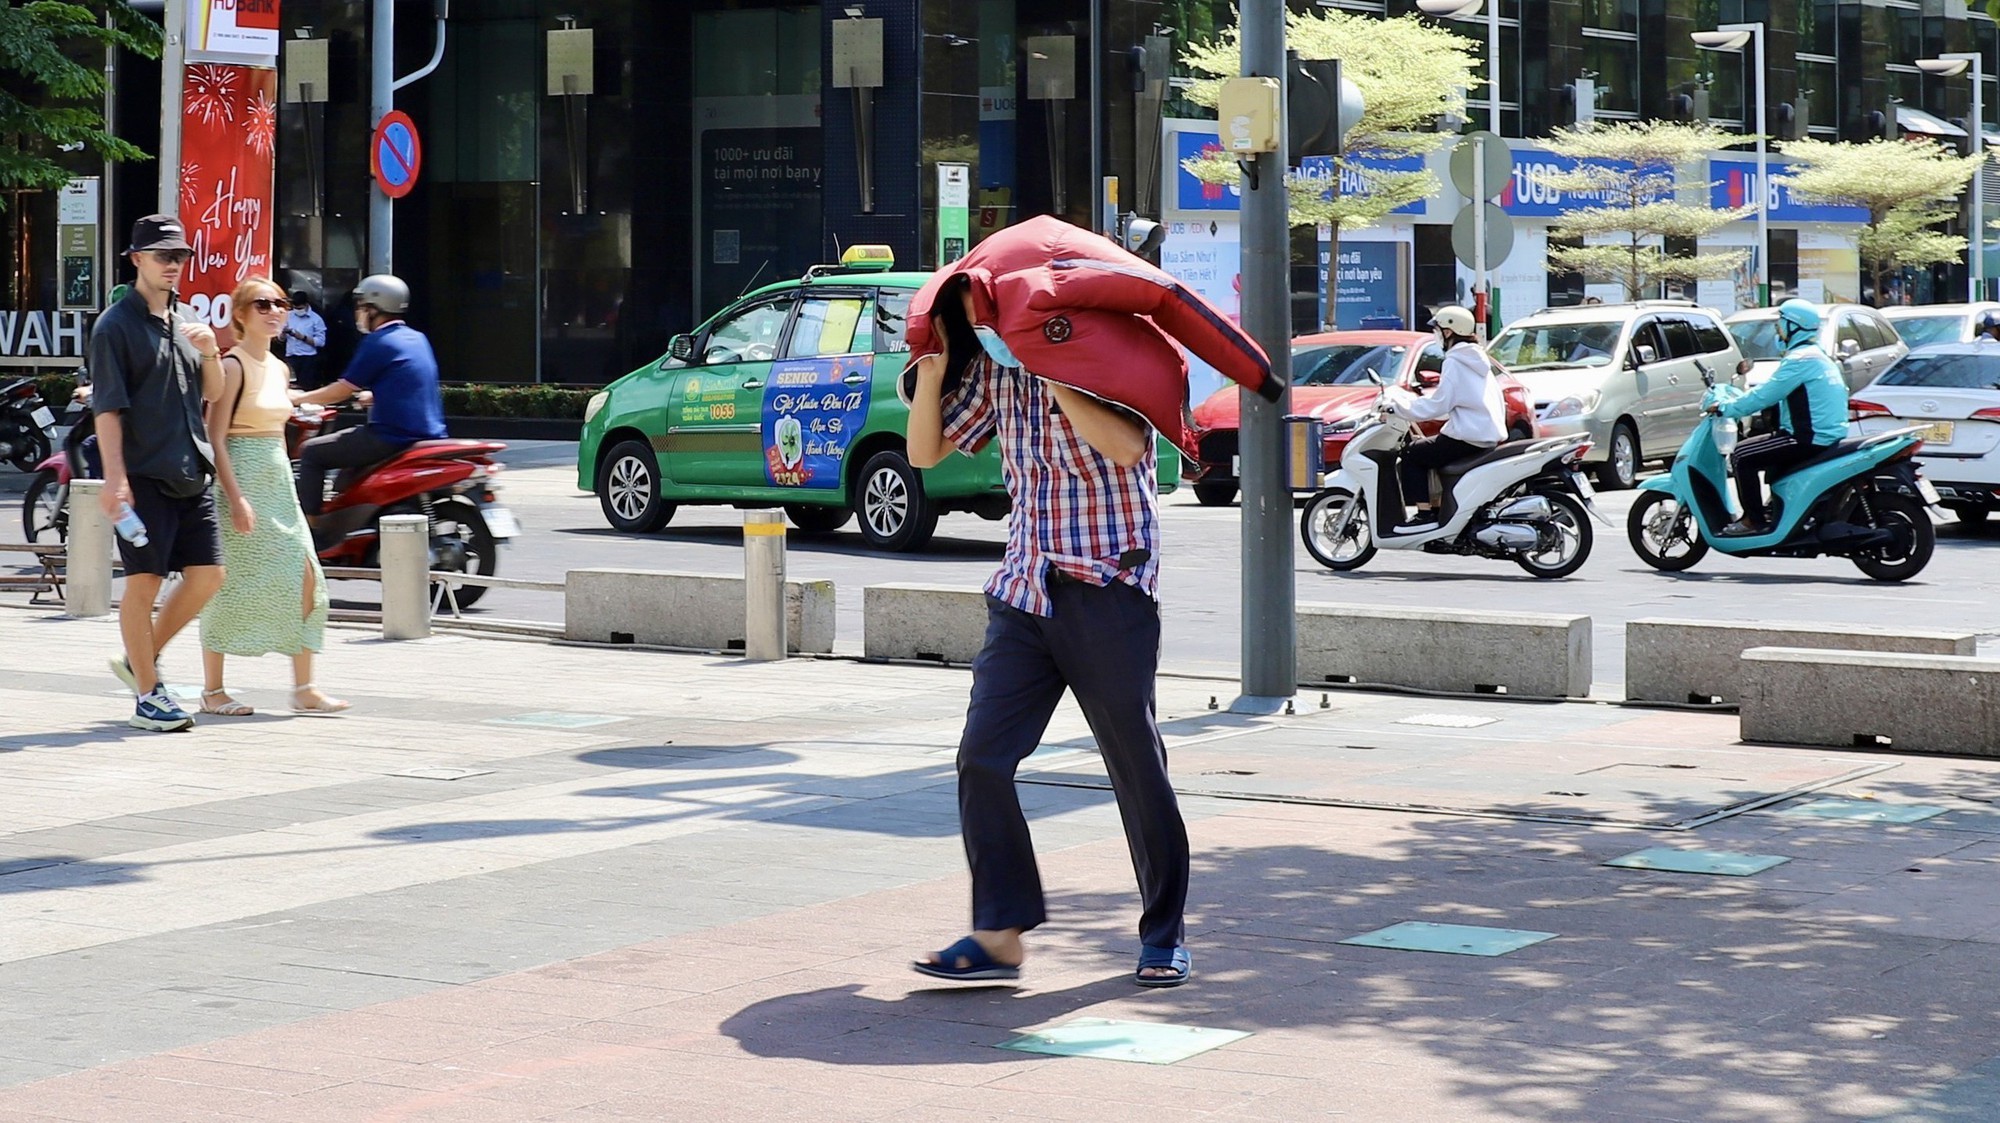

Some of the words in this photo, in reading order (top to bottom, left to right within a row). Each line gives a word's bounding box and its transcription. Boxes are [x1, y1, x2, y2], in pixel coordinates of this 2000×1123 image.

[714, 147, 749, 161] 1000+
[752, 149, 770, 161] ưu
[773, 146, 793, 160] đãi
[714, 166, 730, 184] tại
[733, 167, 758, 183] mọi
[785, 165, 810, 182] bạn
[1516, 163, 1560, 205] UOB
[1744, 173, 1779, 211] UB
[200, 165, 261, 231] Happy
[1170, 221, 1185, 235] UOB
[188, 224, 228, 282] New
[234, 227, 267, 283] Year
[1163, 252, 1179, 263] Mua
[776, 372, 818, 384] SENKO
[709, 402, 735, 420] 1055
